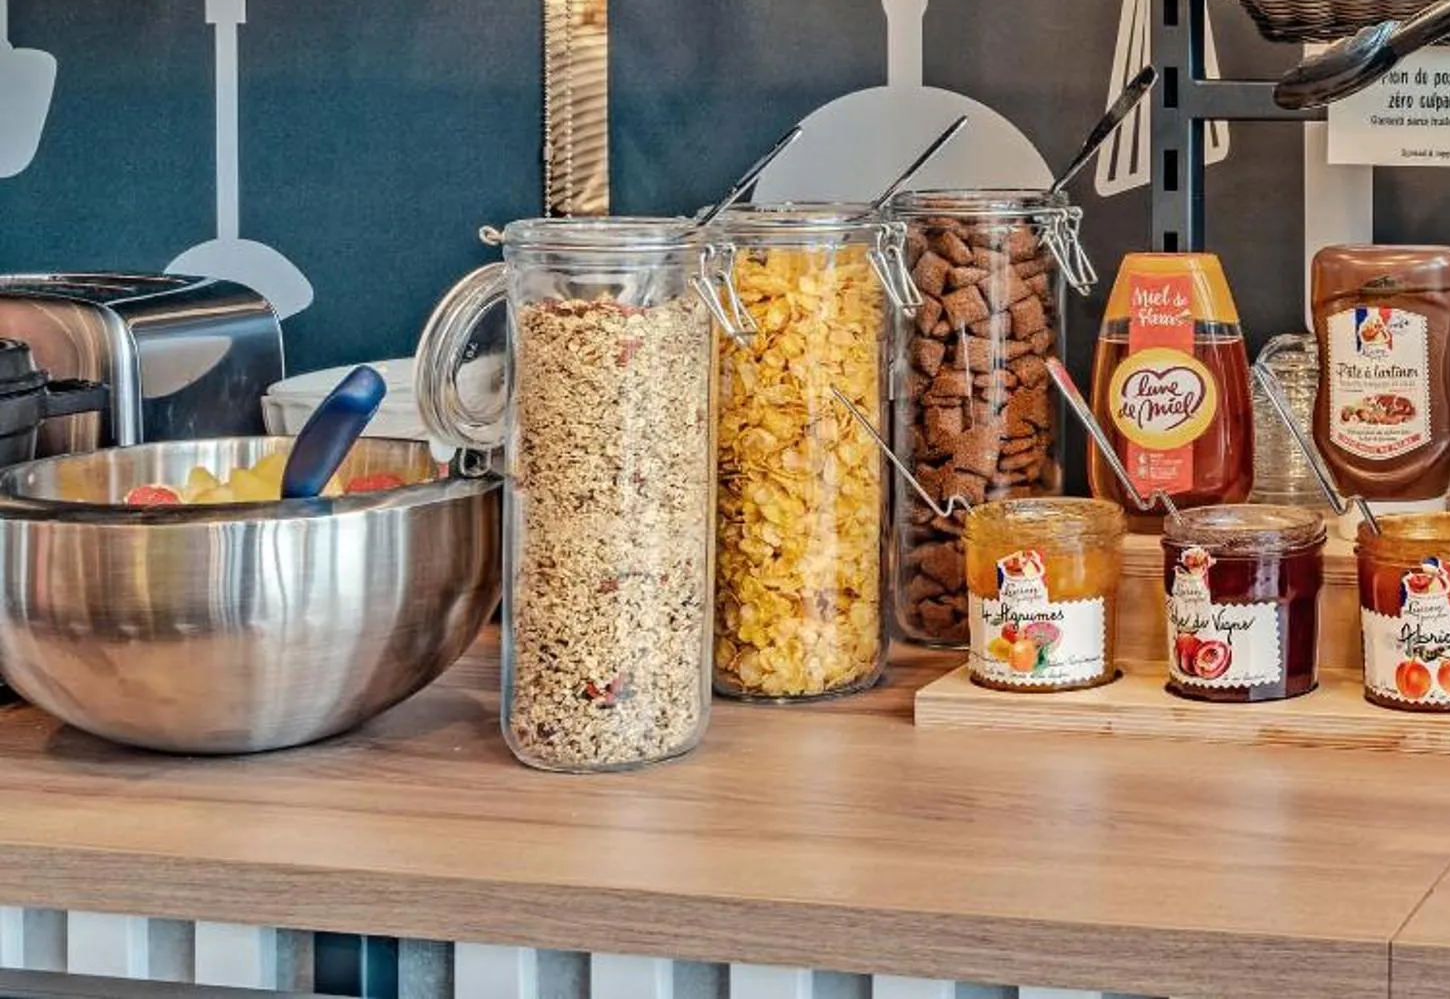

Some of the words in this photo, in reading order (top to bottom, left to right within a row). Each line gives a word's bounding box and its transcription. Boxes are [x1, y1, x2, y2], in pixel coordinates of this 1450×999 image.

[1414, 67, 1429, 85] de
[1388, 91, 1414, 109] zéro
[1132, 284, 1170, 308] Miel
[1118, 399, 1137, 420] de
[980, 604, 993, 623] 4
[995, 602, 1065, 629] Agrumes
